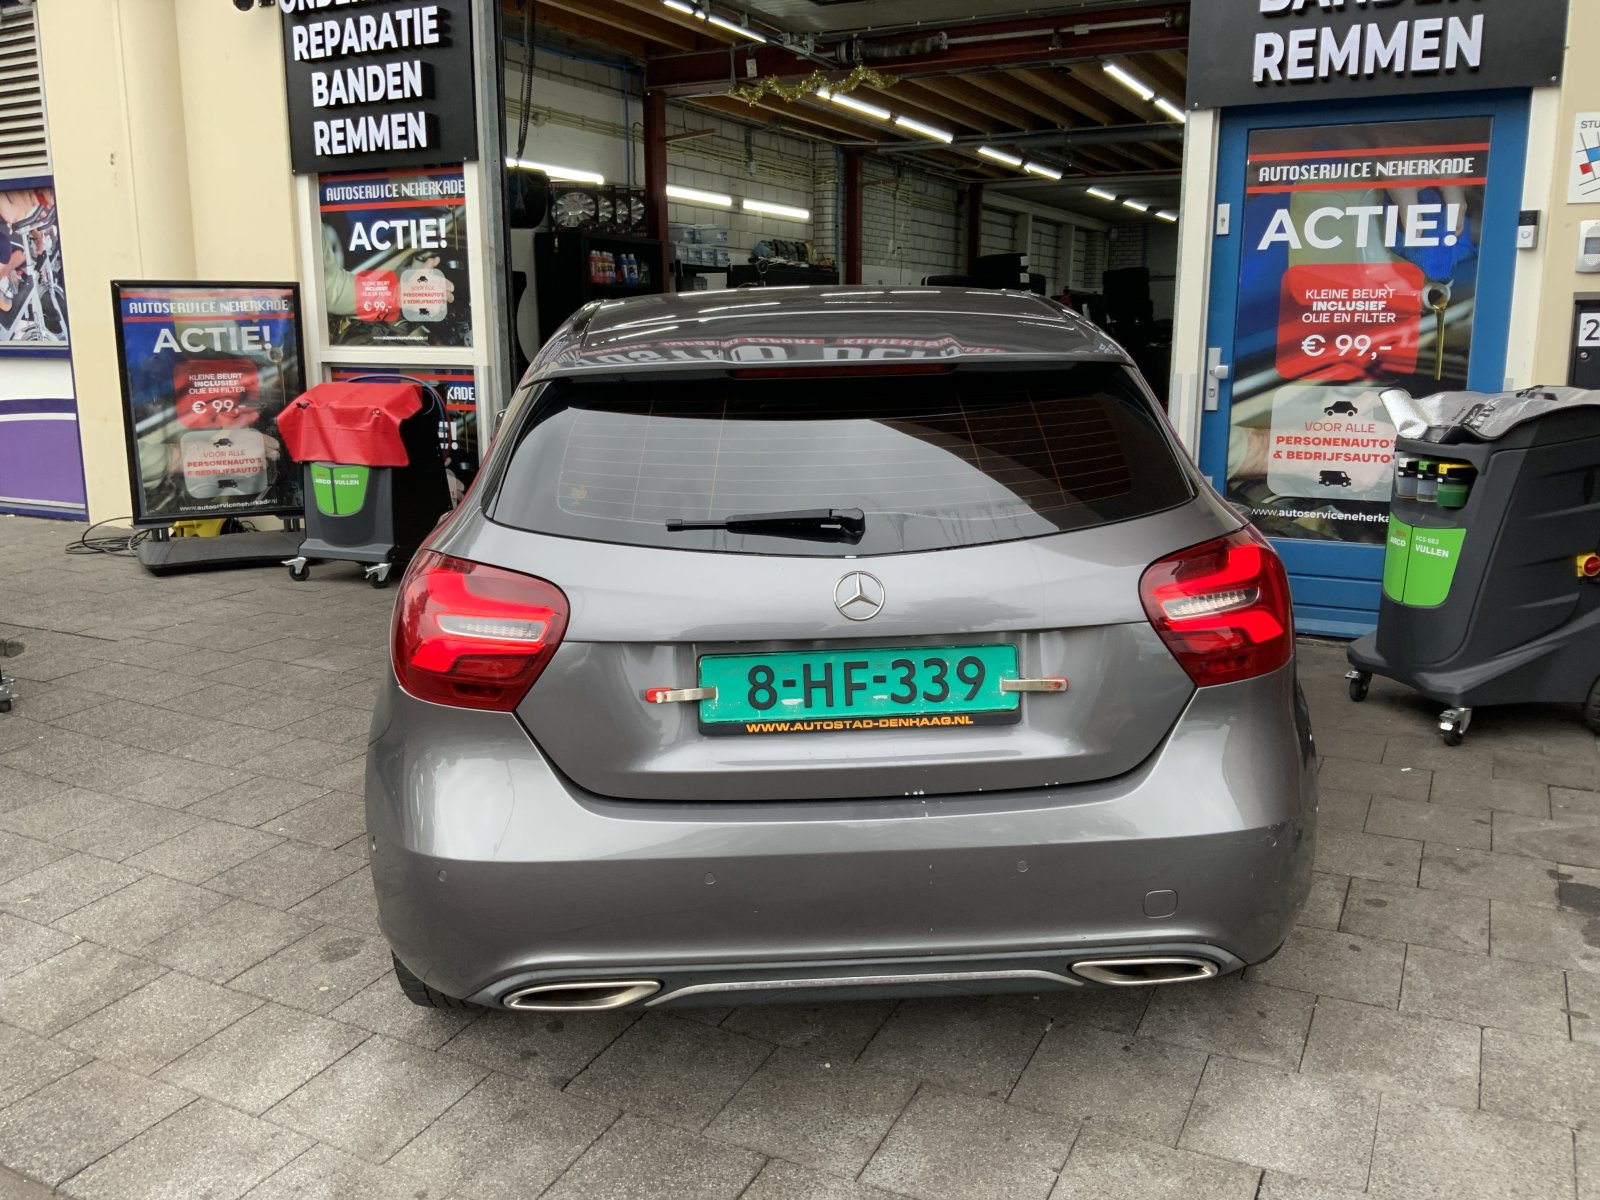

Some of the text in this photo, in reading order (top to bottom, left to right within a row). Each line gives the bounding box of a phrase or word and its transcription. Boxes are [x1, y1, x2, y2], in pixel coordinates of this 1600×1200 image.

[292, 6, 440, 61] REPARATIE
[1252, 14, 1484, 82] REMMEN
[311, 60, 422, 107] BANDEN
[313, 111, 427, 156] REMMEN
[1259, 157, 1475, 182] AUTOSERVICE NEHERKADE
[326, 179, 465, 202] AUTOSERVICE NEHERKADE
[349, 218, 448, 251] ACTIE!
[1256, 203, 1461, 251] ACTIE!
[1305, 288, 1396, 299] KLEINE BEURT
[129, 299, 289, 314] AUTOSERVICE NEHERKADE
[1312, 301, 1387, 311] INCLUSIEF
[1301, 313, 1396, 323] OLIE EN FILTER
[153, 325, 272, 354] ACTIE!
[1301, 334, 1392, 361] € 99,-
[192, 400, 207, 414] €
[1305, 422, 1376, 434] VOOR ALLE
[1276, 436, 1396, 449] PERSONENAUTO'
[1273, 450, 1283, 460] &
[1286, 451, 1395, 464] BEDRIJFSAUTO'
[1415, 543, 1450, 558] VULLEN
[747, 655, 987, 711] 8-HF-339
[746, 715, 974, 734] WWW.AUTOSTAD-DENHAAG.NL
